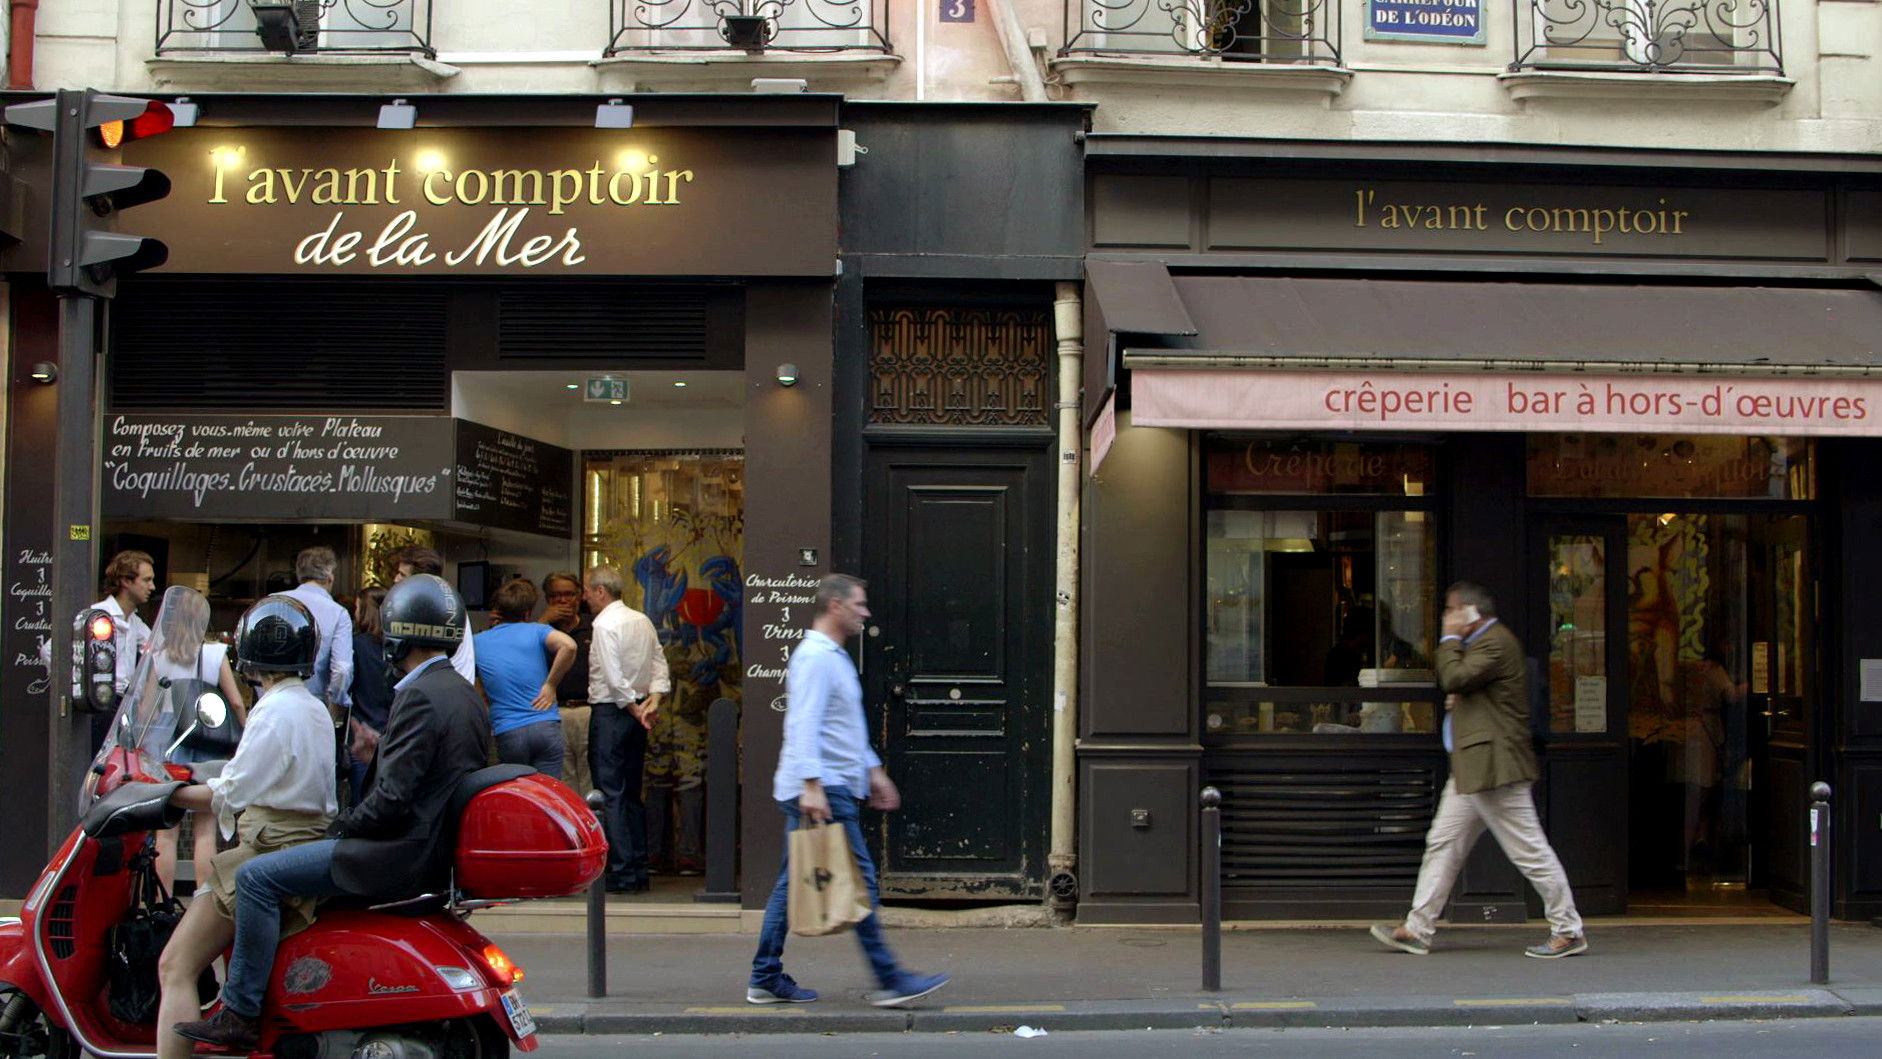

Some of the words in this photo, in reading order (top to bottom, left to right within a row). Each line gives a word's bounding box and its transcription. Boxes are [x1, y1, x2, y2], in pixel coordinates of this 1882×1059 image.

[949, 0, 965, 18] 3
[1376, 9, 1399, 24] DE
[1404, 8, 1476, 27] L'ODÉON
[423, 154, 694, 215] comptoir
[1354, 189, 1488, 231] l'avant
[1504, 197, 1689, 244] comptoir
[294, 210, 363, 265] de
[366, 209, 436, 267] la
[444, 207, 586, 267] Mer
[1324, 380, 1473, 421] crêperie
[1507, 381, 1567, 414] bar
[1576, 383, 1595, 415] à
[112, 415, 186, 443] Composez
[278, 421, 314, 438] votre
[321, 416, 383, 438] Plateau
[111, 444, 132, 457] en
[185, 441, 203, 458] de
[207, 447, 241, 458] mer
[250, 447, 271, 459] ou
[745, 573, 820, 588] Charcuteries
[751, 592, 765, 603] de
[768, 591, 817, 604] Poissons
[762, 623, 804, 639] Vins
[747, 663, 791, 685] Champ
